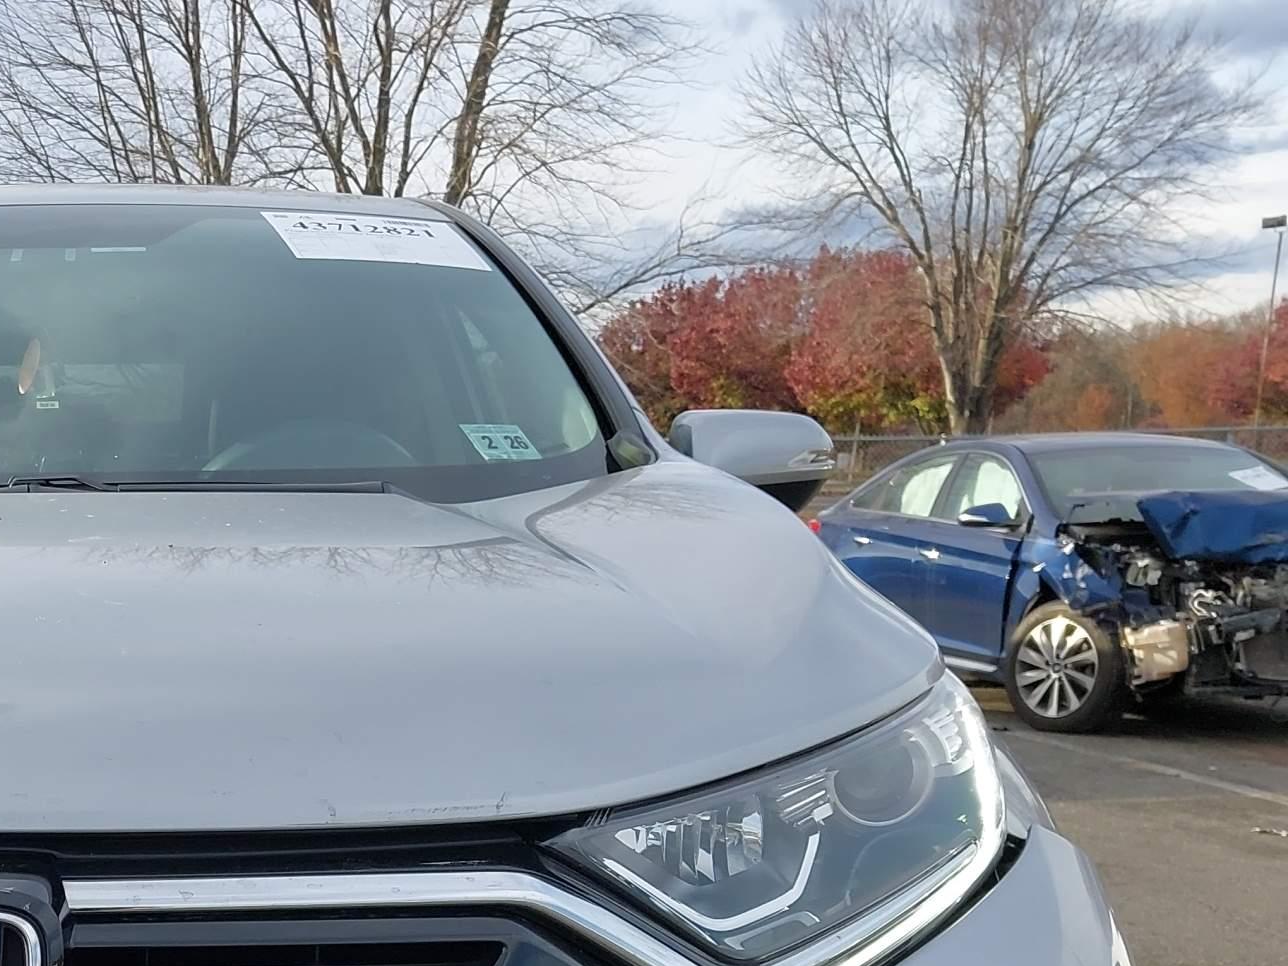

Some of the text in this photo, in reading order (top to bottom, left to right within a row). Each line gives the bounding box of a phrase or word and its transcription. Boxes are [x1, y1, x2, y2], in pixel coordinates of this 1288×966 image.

[291, 221, 436, 238] 43712821
[480, 435, 530, 450] 2 26
